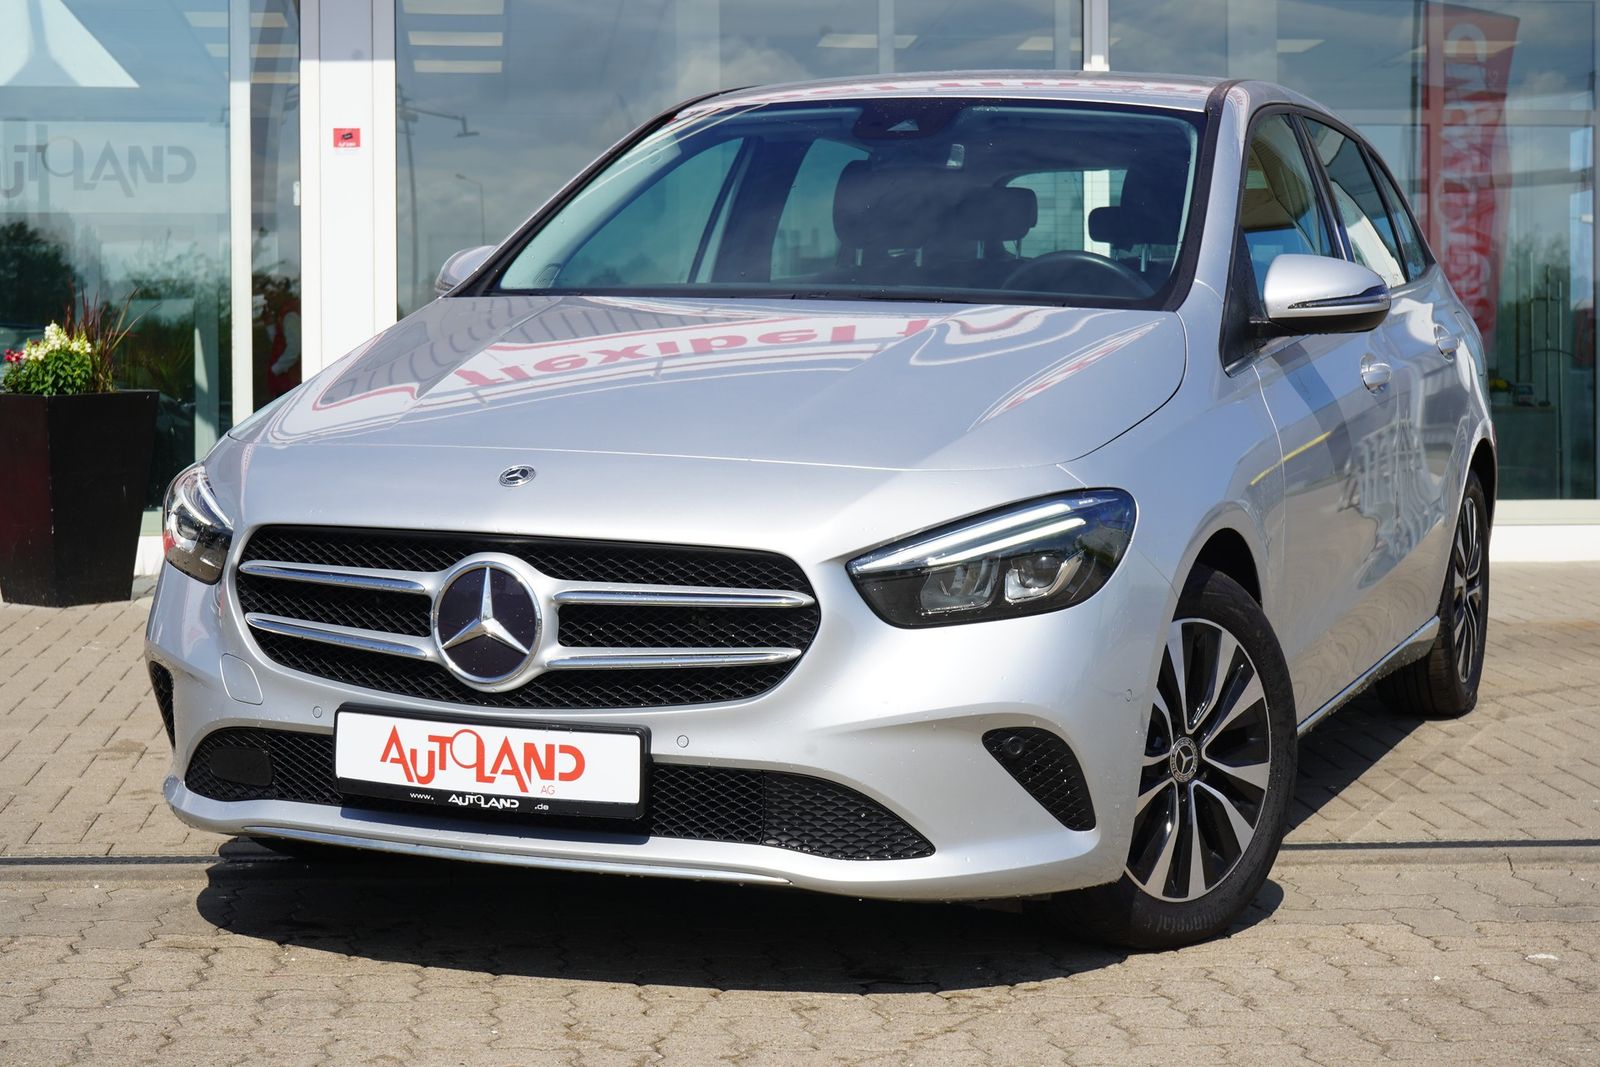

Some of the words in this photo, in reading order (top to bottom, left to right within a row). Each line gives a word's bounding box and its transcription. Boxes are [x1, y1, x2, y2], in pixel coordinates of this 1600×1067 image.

[0, 136, 197, 198] UTOLAND
[540, 784, 556, 796] AG
[409, 792, 434, 801] www.
[534, 803, 550, 811] .de
